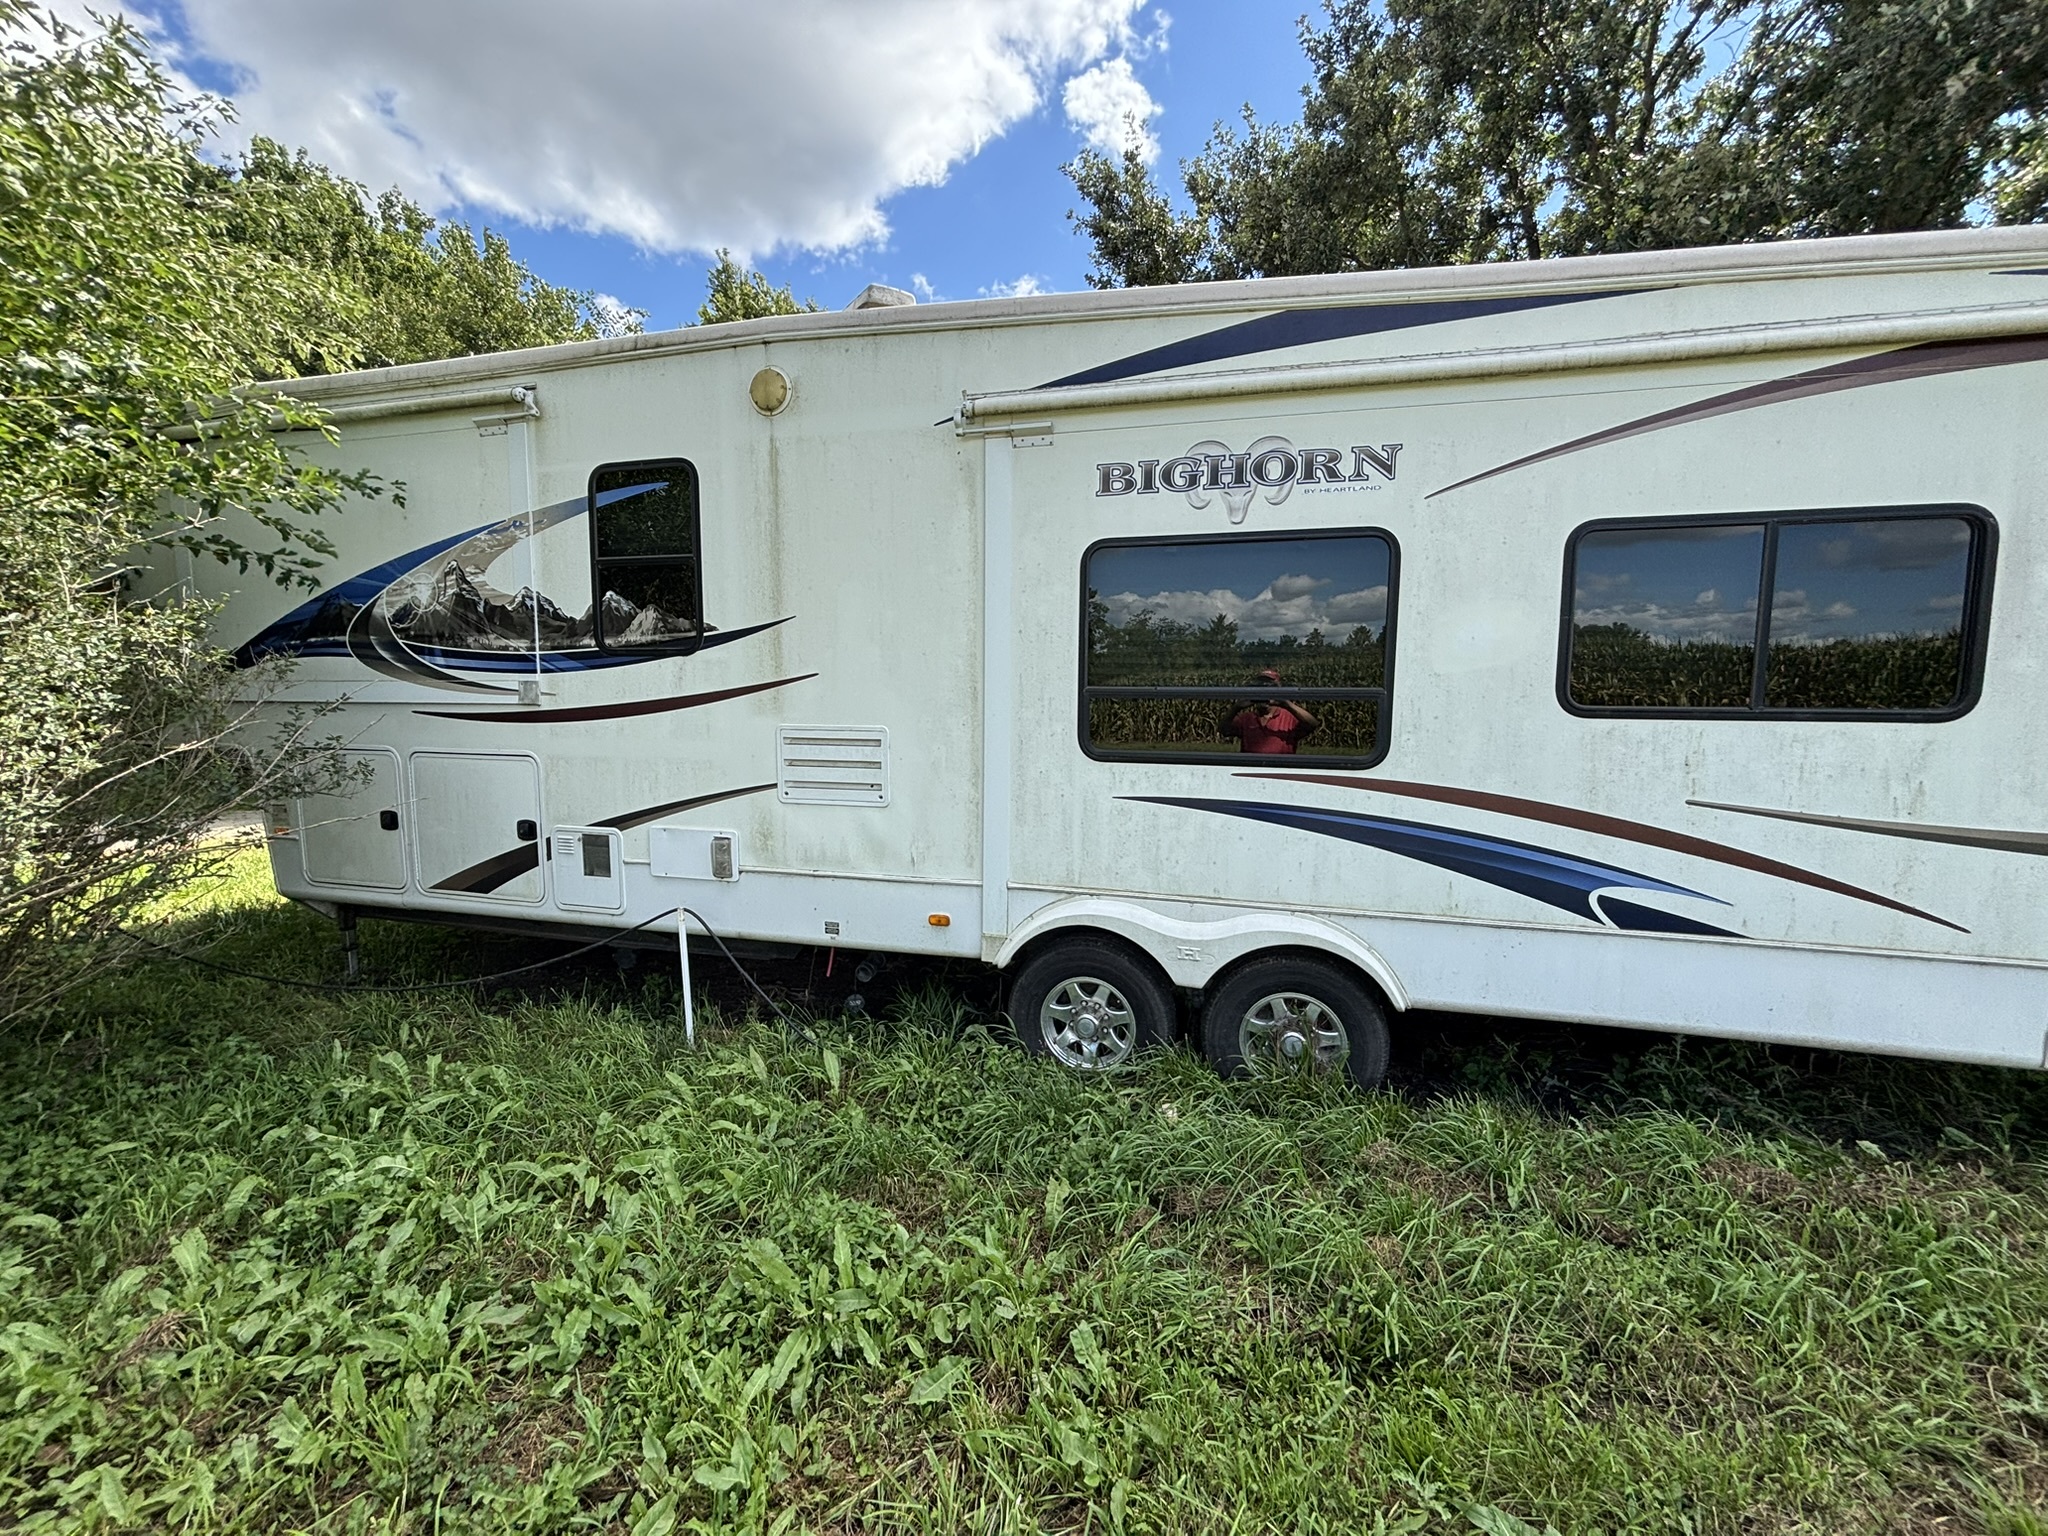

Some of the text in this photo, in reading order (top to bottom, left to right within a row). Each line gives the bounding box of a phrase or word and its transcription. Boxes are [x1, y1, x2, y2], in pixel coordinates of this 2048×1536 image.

[1096, 443, 1403, 497] BIGHORN
[1303, 484, 1382, 495] BY HEARTLAND
